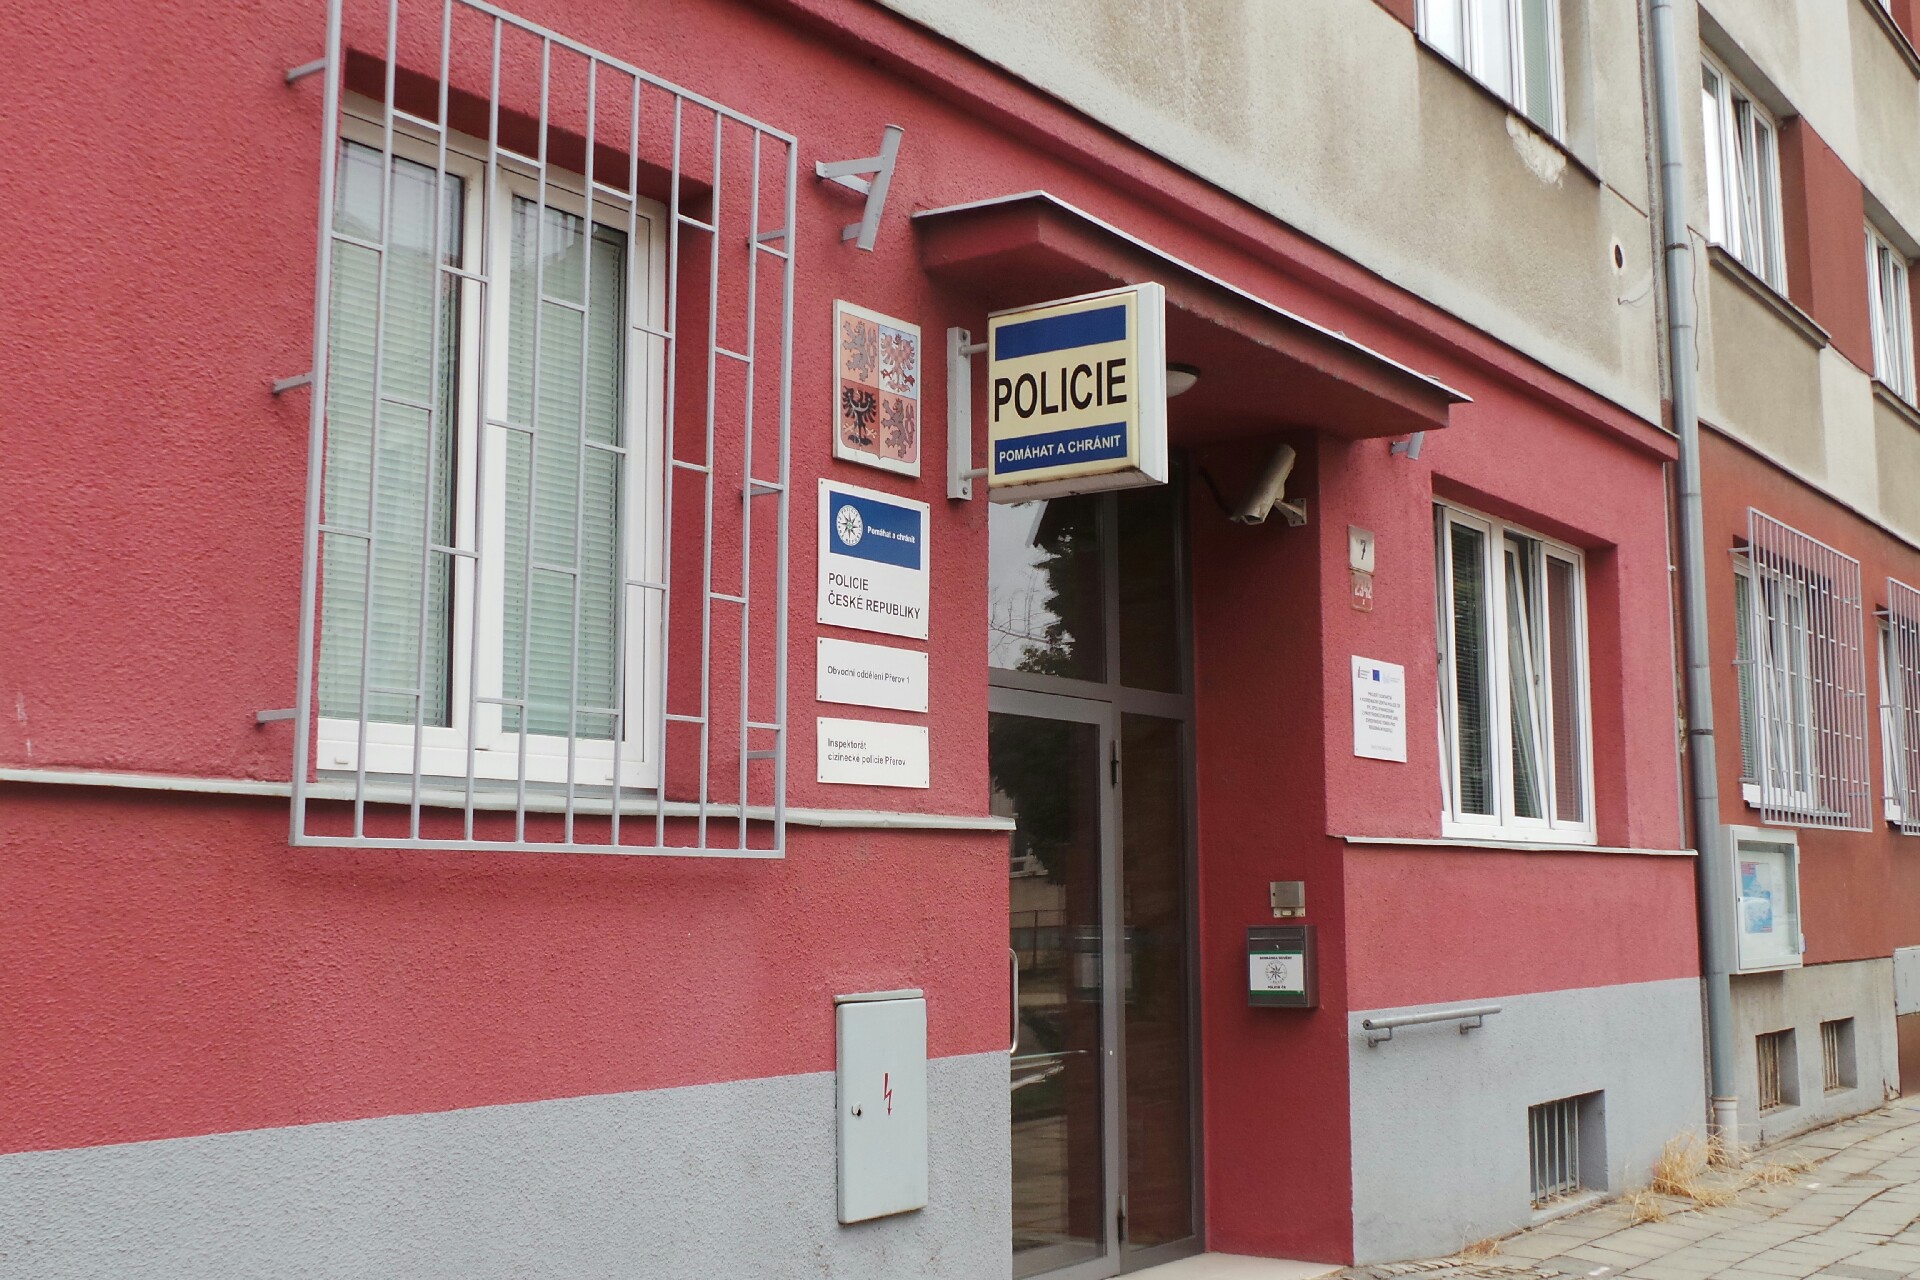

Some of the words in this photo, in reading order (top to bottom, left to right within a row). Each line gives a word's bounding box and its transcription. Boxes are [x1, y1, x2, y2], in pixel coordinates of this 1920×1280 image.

[994, 357, 1127, 422] POLICIE
[999, 444, 1054, 463] POMÁHAT
[1056, 442, 1066, 454] A
[1068, 434, 1121, 453] CHRÁNIT
[868, 526, 891, 538] Pomáhat
[896, 532, 915, 543] chránit
[1360, 538, 1367, 560] 7
[828, 572, 869, 591] POLICIE
[828, 590, 863, 610] ČESKÉ
[866, 599, 920, 619] REPUBLIKY
[827, 665, 856, 678] Obvodní
[857, 669, 884, 681] oddělení
[884, 672, 905, 684] Přerov
[906, 676, 910, 684] 1
[827, 738, 867, 750] Inspektorát
[827, 752, 860, 763] cizinecké
[861, 754, 884, 765] policie
[884, 755, 906, 766] Přerov
